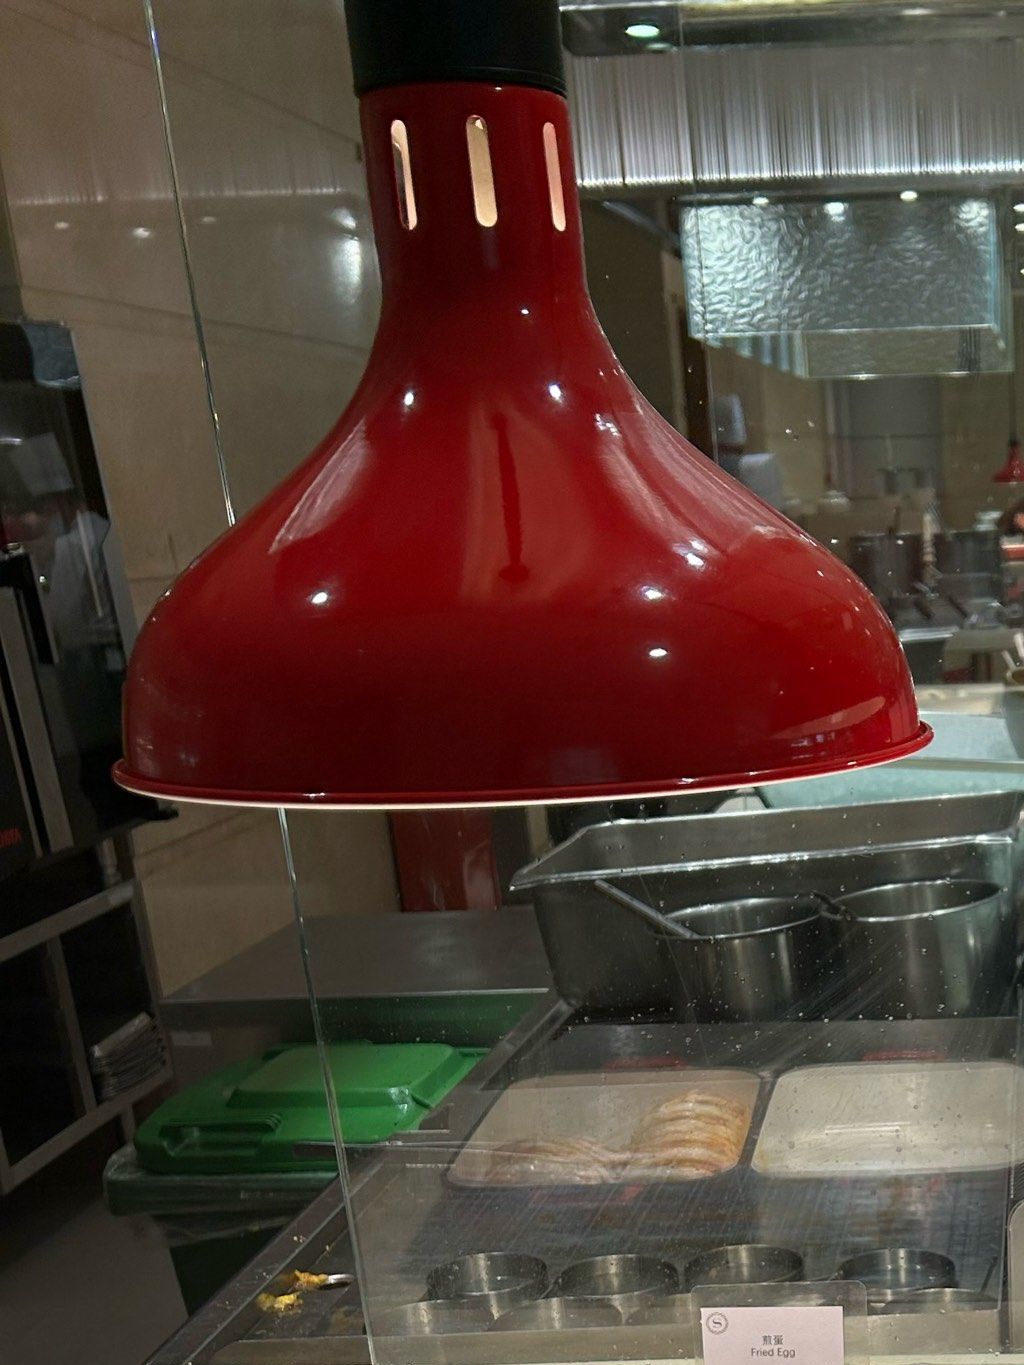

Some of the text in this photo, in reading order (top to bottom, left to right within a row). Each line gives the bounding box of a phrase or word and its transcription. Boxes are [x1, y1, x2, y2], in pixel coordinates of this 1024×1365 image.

[762, 1335, 784, 1345] 煎蛋
[751, 1348, 796, 1358] Fried Egg
